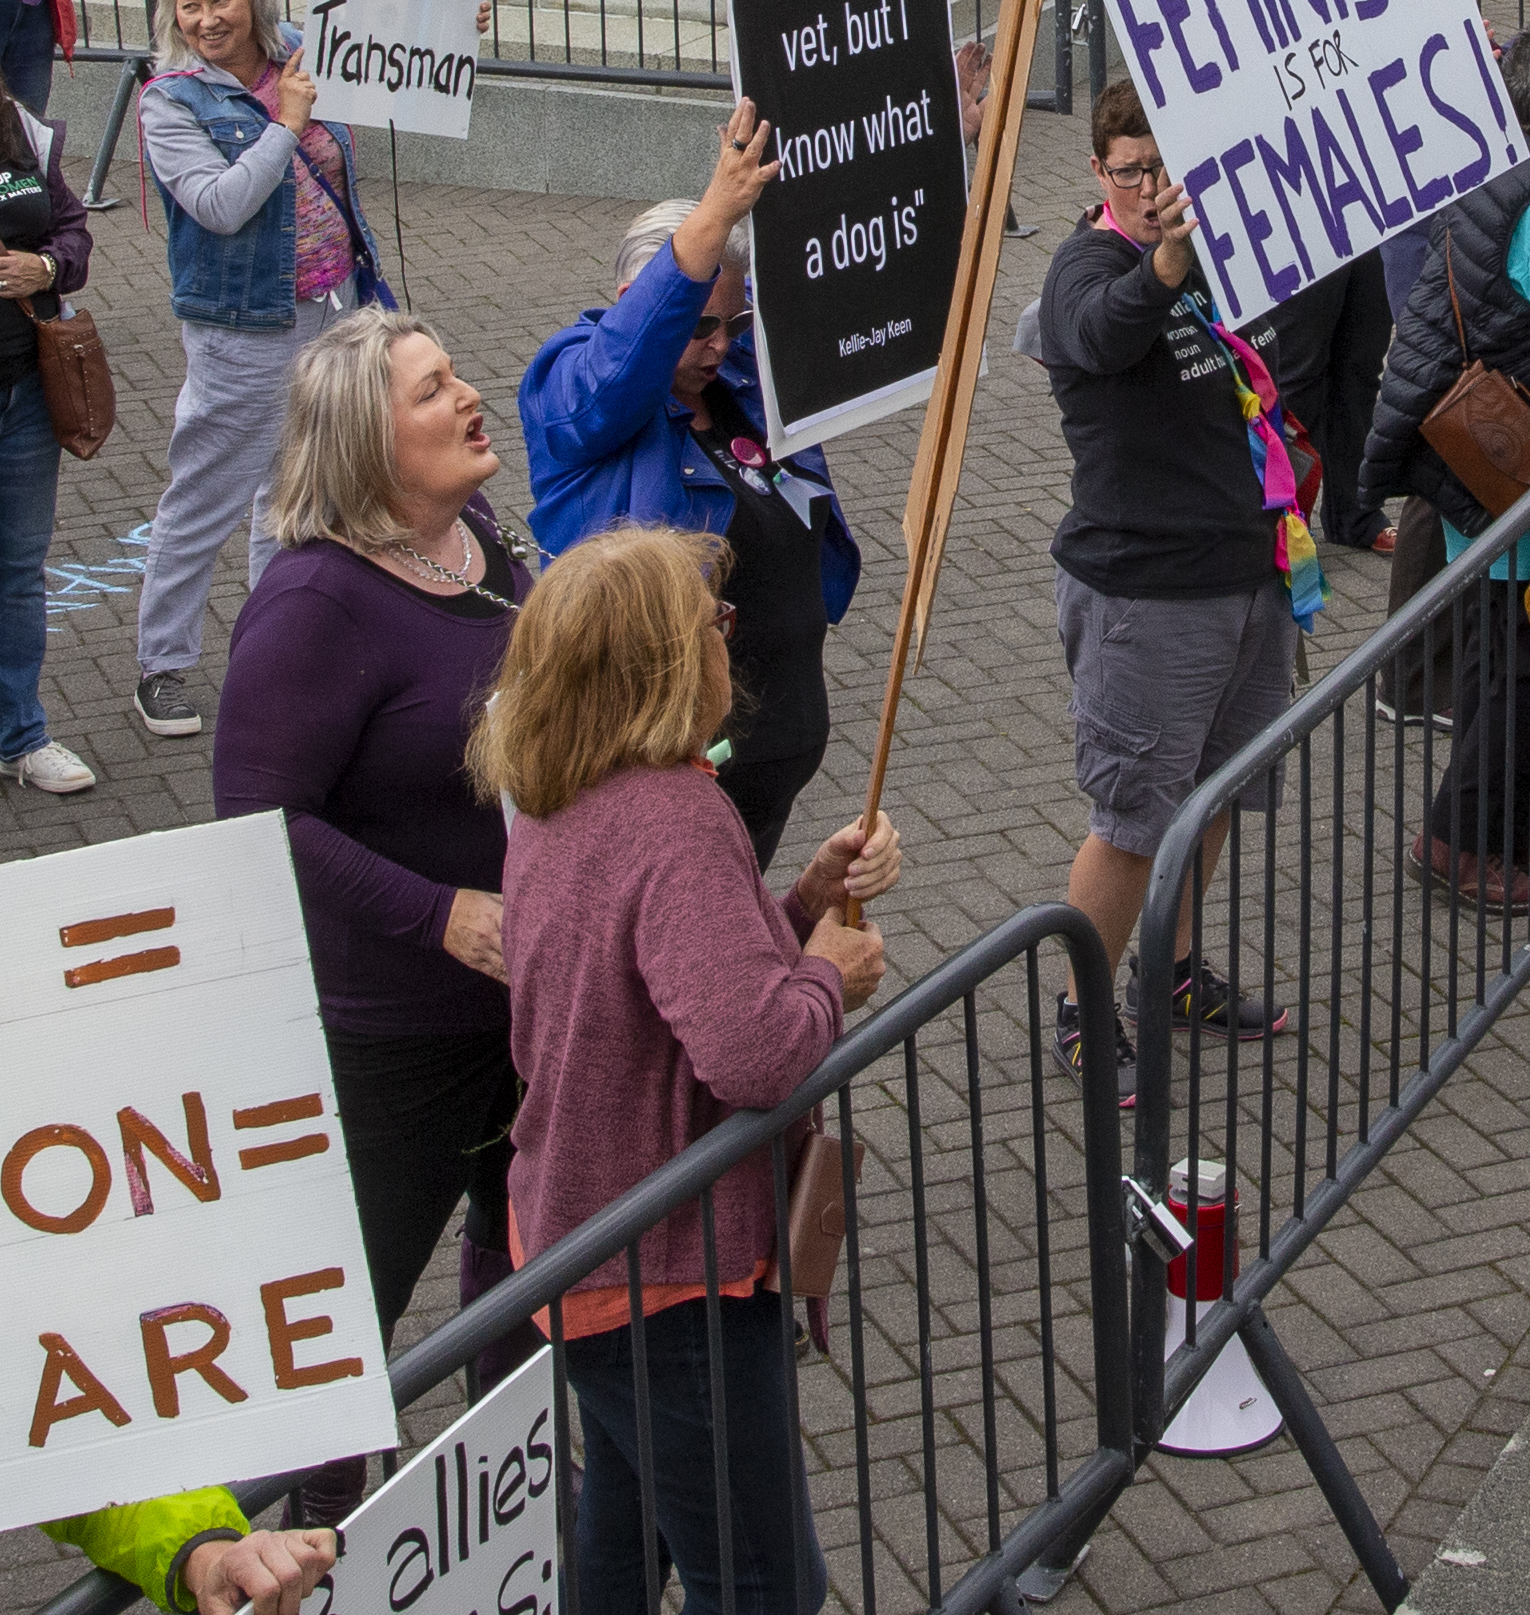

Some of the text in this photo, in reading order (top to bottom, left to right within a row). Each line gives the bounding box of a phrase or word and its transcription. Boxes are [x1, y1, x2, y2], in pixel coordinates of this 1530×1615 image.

[781, 10, 839, 72] vet,
[845, 0, 894, 58] but
[1273, 29, 1360, 111] IS FOR
[775, 90, 935, 183] know what
[1183, 18, 1519, 319] FEMALES!
[805, 189, 926, 279] a dog is"
[838, 317, 912, 359] Kellie-Jay Keen
[1174, 343, 1202, 360] noun
[1180, 356, 1218, 382] adult
[28, 1265, 366, 1449] ARE
[385, 1406, 553, 1613] allies
